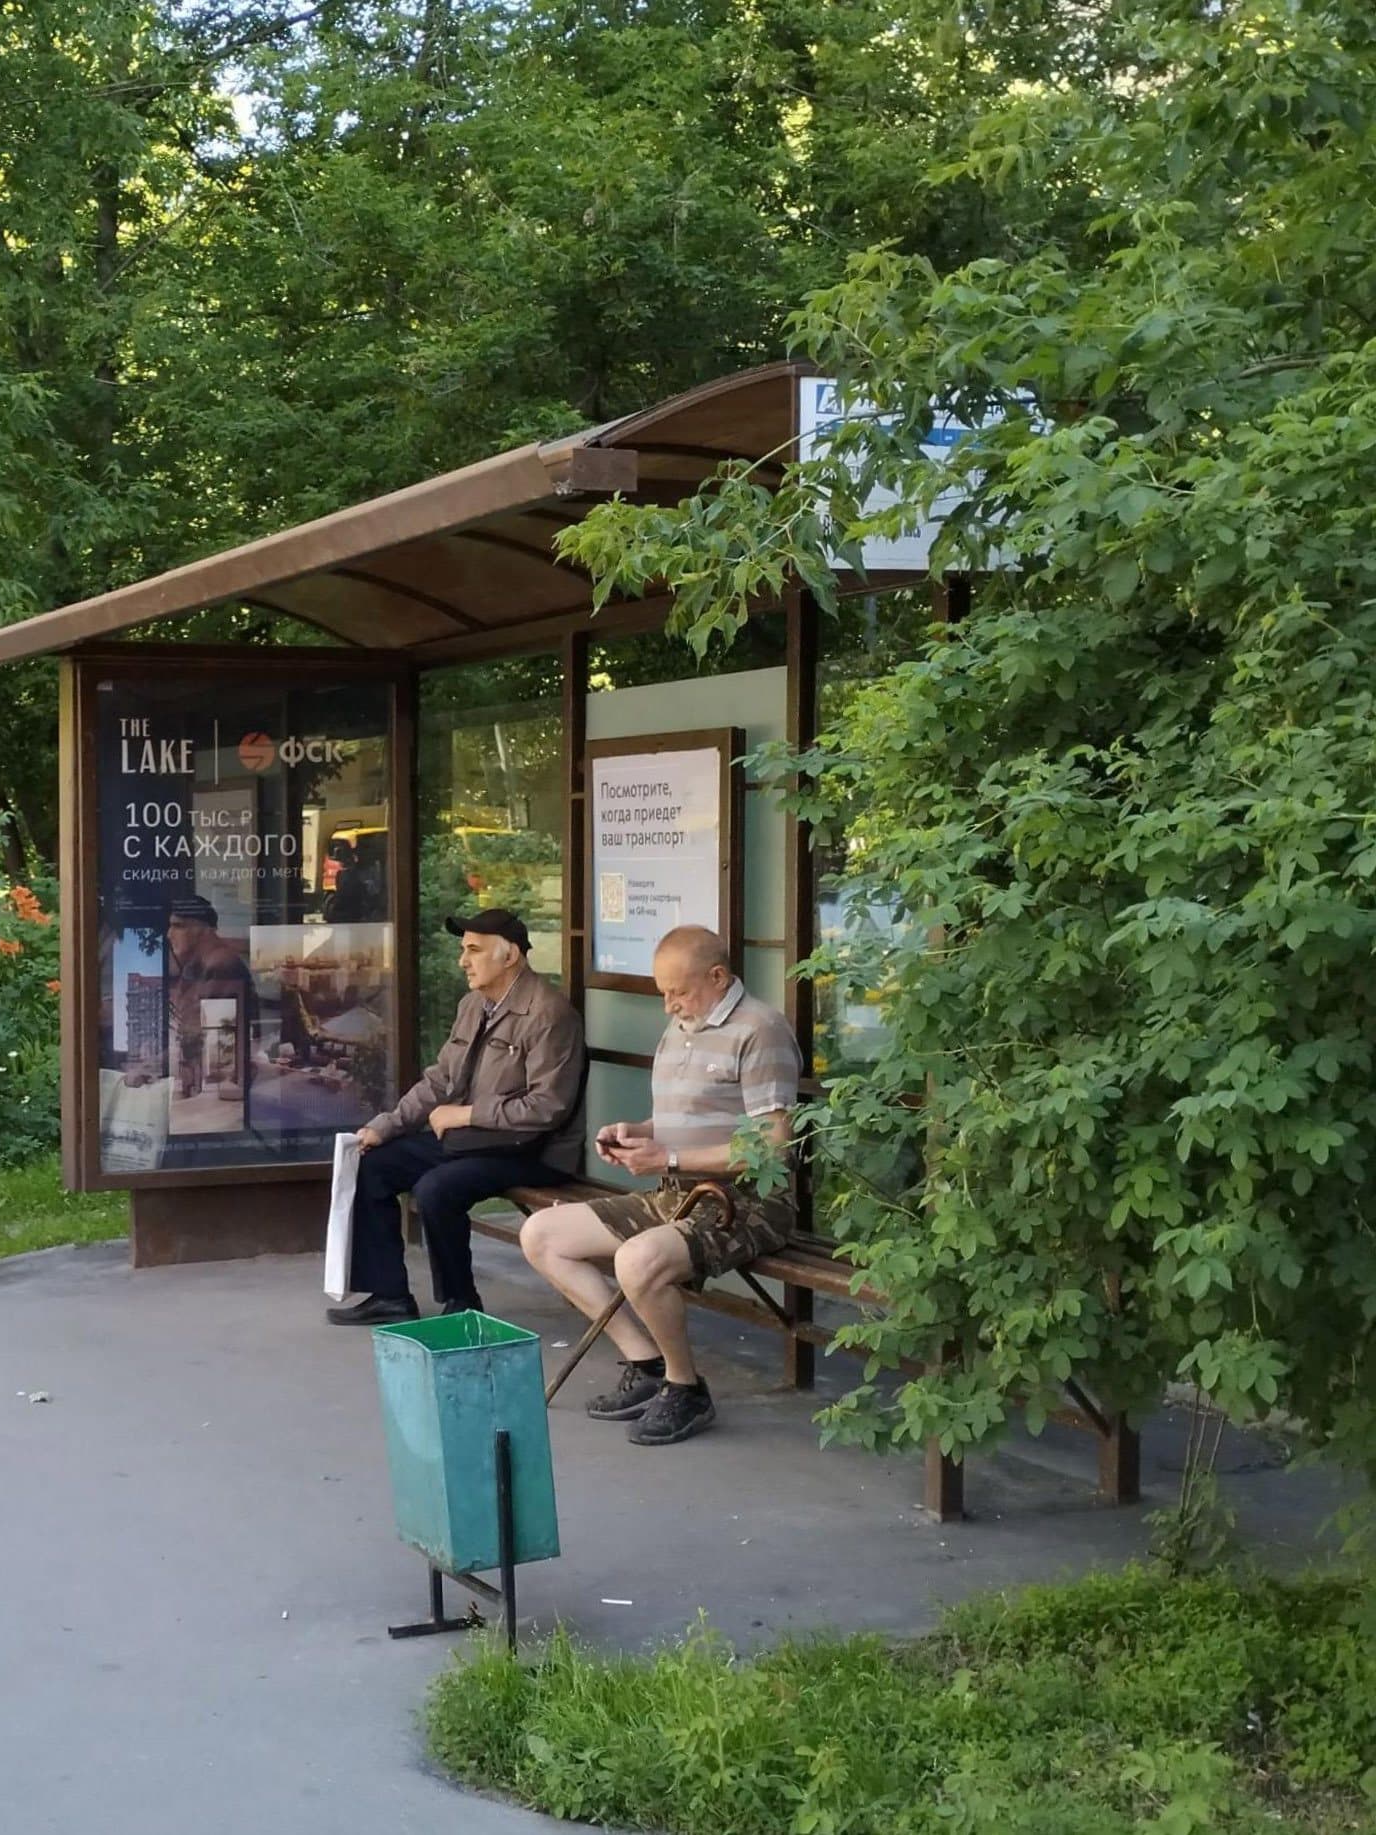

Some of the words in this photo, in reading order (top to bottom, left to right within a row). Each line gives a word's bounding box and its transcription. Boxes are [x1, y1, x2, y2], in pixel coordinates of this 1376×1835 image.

[120, 718, 151, 737] THE
[121, 739, 195, 774] LAKE
[600, 781, 672, 801] Посмотрите,
[125, 802, 182, 828] 100
[600, 807, 631, 825] когда
[634, 805, 682, 827] приедет
[124, 835, 141, 858] С
[154, 833, 298, 862] КАЖДОГО
[601, 832, 623, 847] ваш
[625, 830, 685, 850] транспорт
[123, 867, 180, 883] скидка
[184, 867, 194, 880] с
[200, 866, 267, 883] каждого
